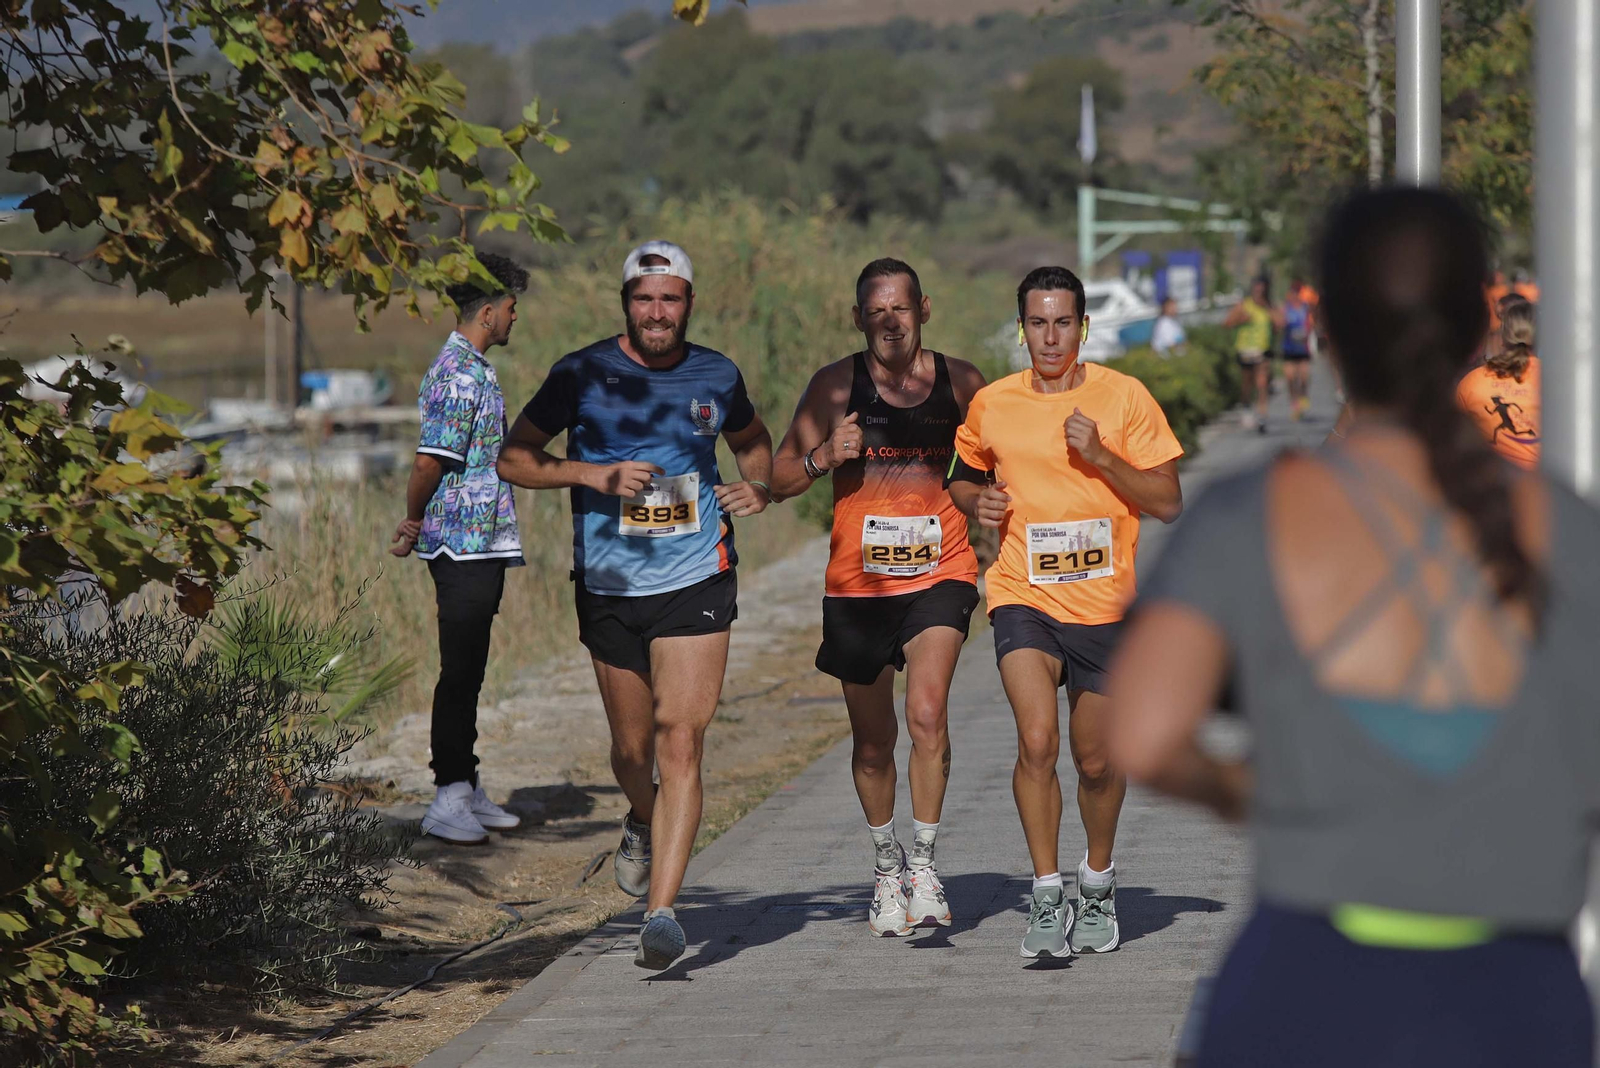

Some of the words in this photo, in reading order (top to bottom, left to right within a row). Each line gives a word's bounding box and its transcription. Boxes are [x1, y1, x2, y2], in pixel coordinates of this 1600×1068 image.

[878, 446, 952, 458] CORREPLAYAS
[630, 503, 689, 523] 393
[871, 544, 932, 562] 254
[1039, 549, 1103, 570] 210
